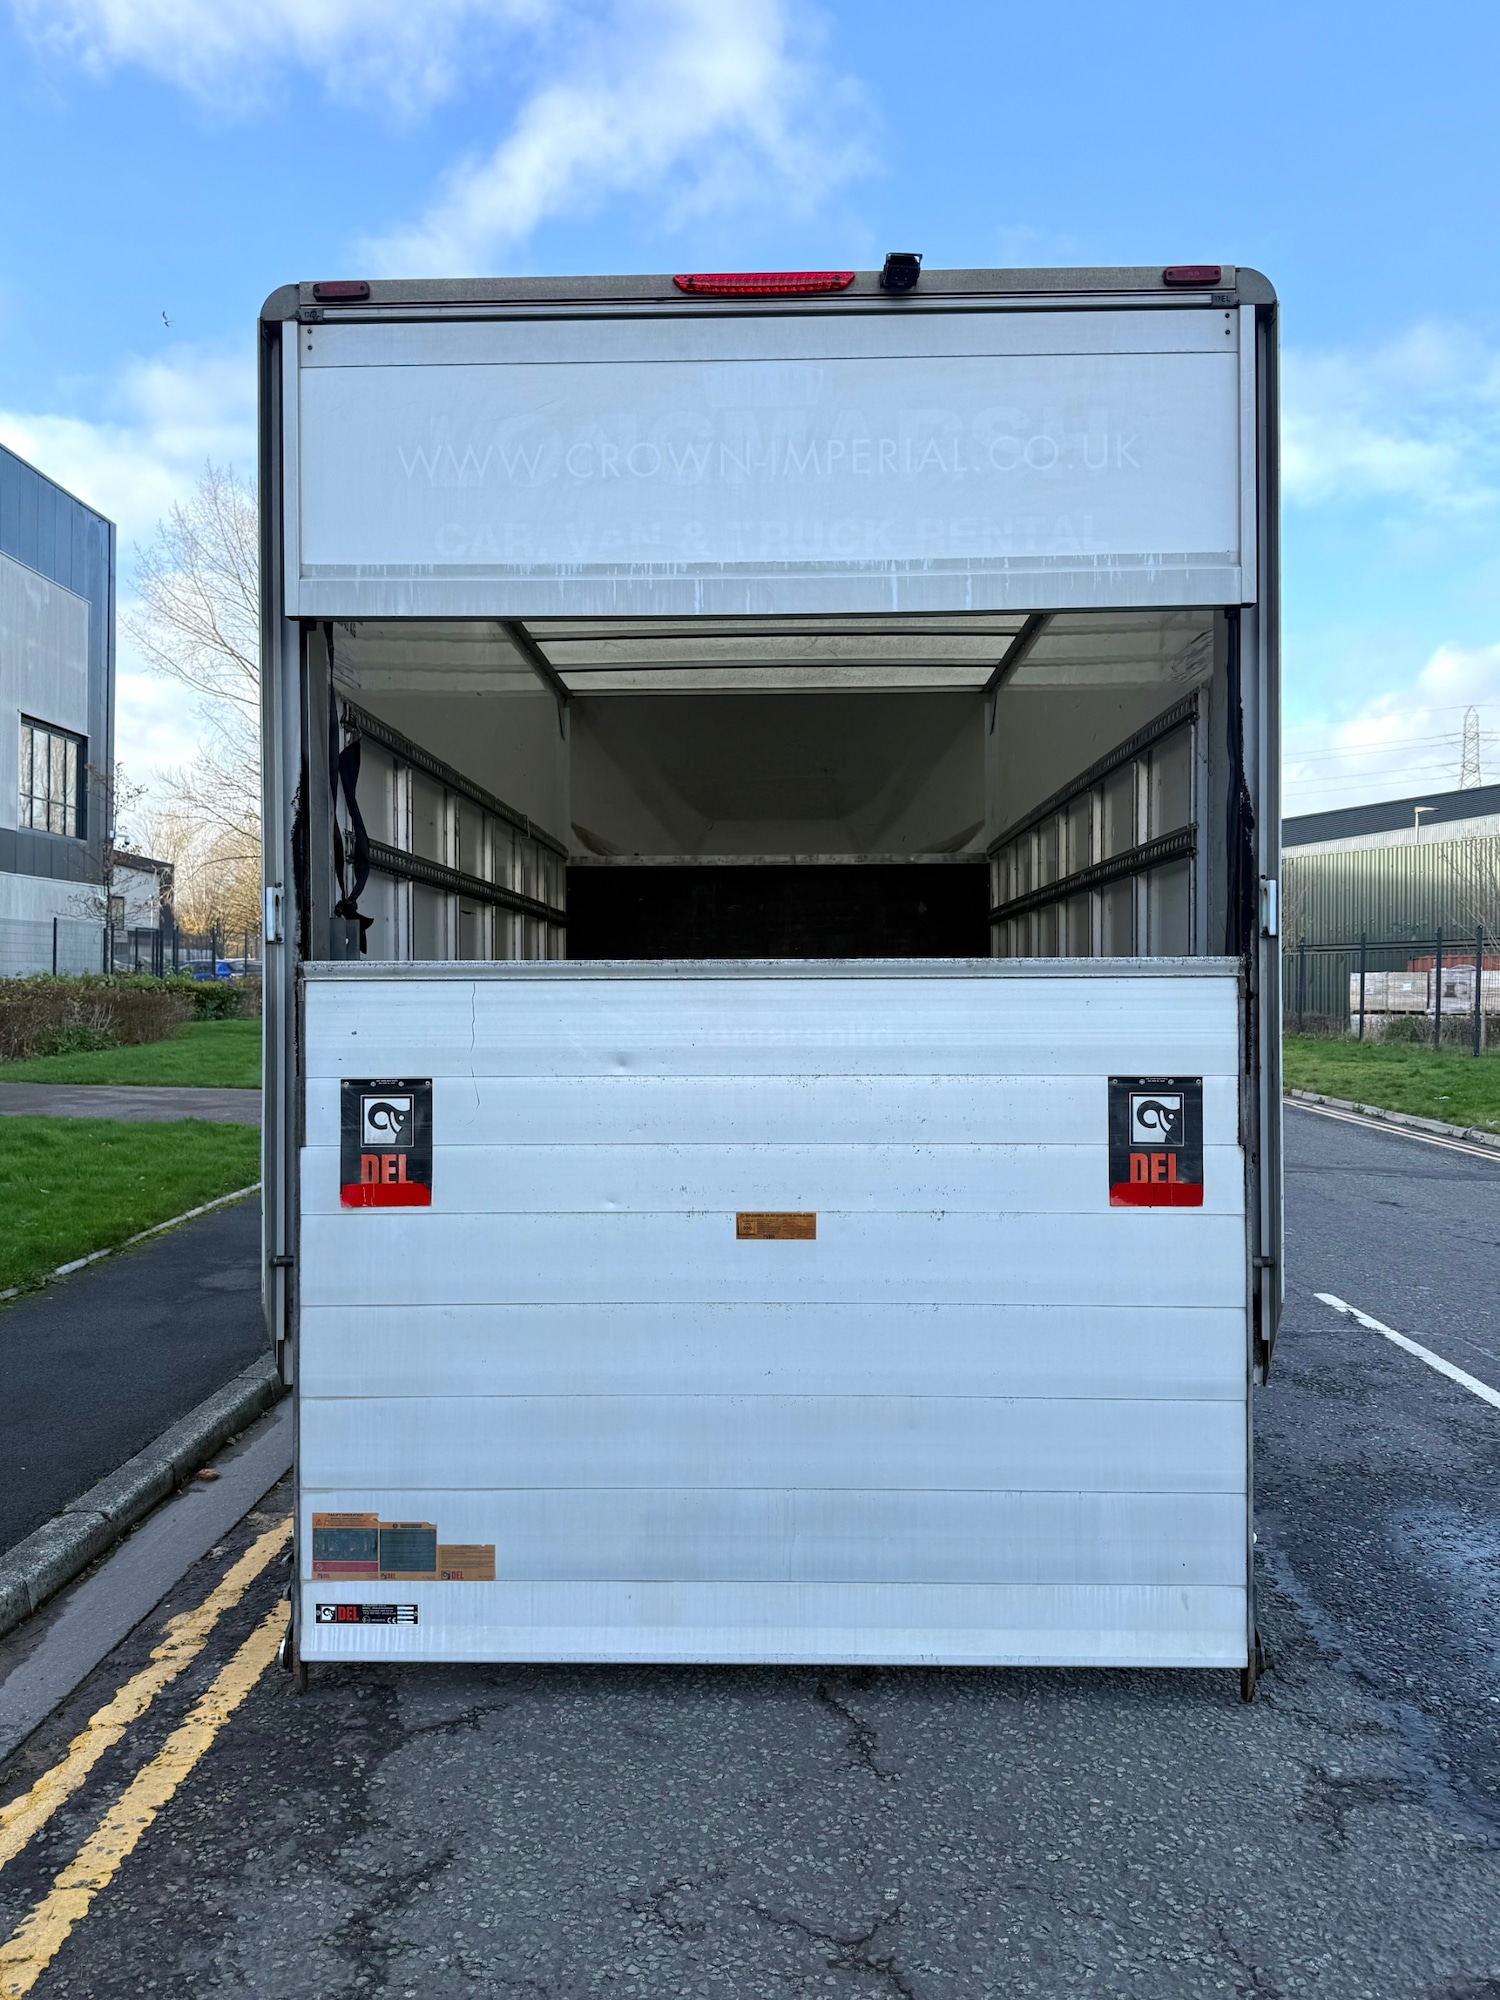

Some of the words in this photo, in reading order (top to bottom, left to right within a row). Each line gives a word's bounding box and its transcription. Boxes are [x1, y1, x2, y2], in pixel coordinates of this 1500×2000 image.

[396, 432, 1141, 481] WWW.CROWN-IMPERIAL.CO.UK
[726, 516, 896, 556] TRUCK
[915, 513, 1110, 554] RENTAL
[360, 1154, 414, 1184] DEL
[1129, 1153, 1184, 1183] DEL
[452, 1571, 465, 1580] DEL
[338, 1606, 359, 1621] DEL
